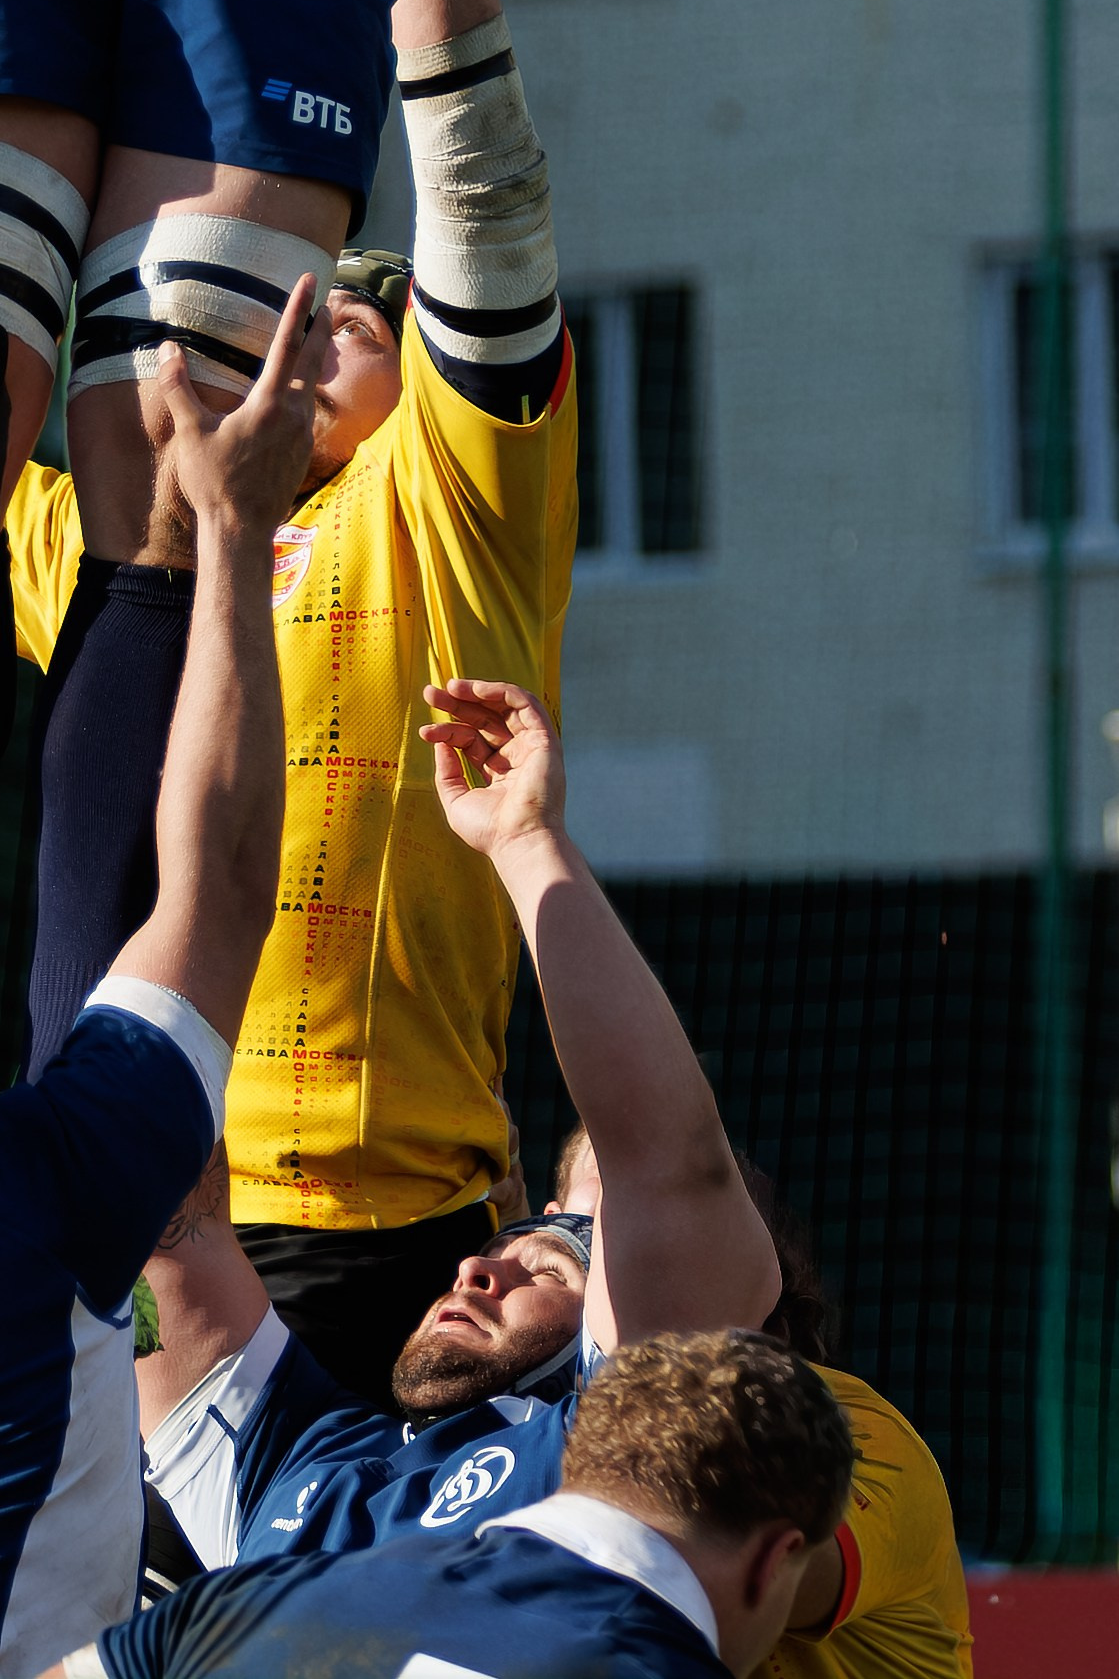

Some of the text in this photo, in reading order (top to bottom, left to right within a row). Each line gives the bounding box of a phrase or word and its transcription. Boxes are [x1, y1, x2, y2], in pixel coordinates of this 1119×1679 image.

[291, 89, 353, 136] ВТБ
[329, 607, 399, 621] МОСКВА
[326, 756, 399, 769] МОСКВА
[236, 1048, 289, 1058] СЛАВА
